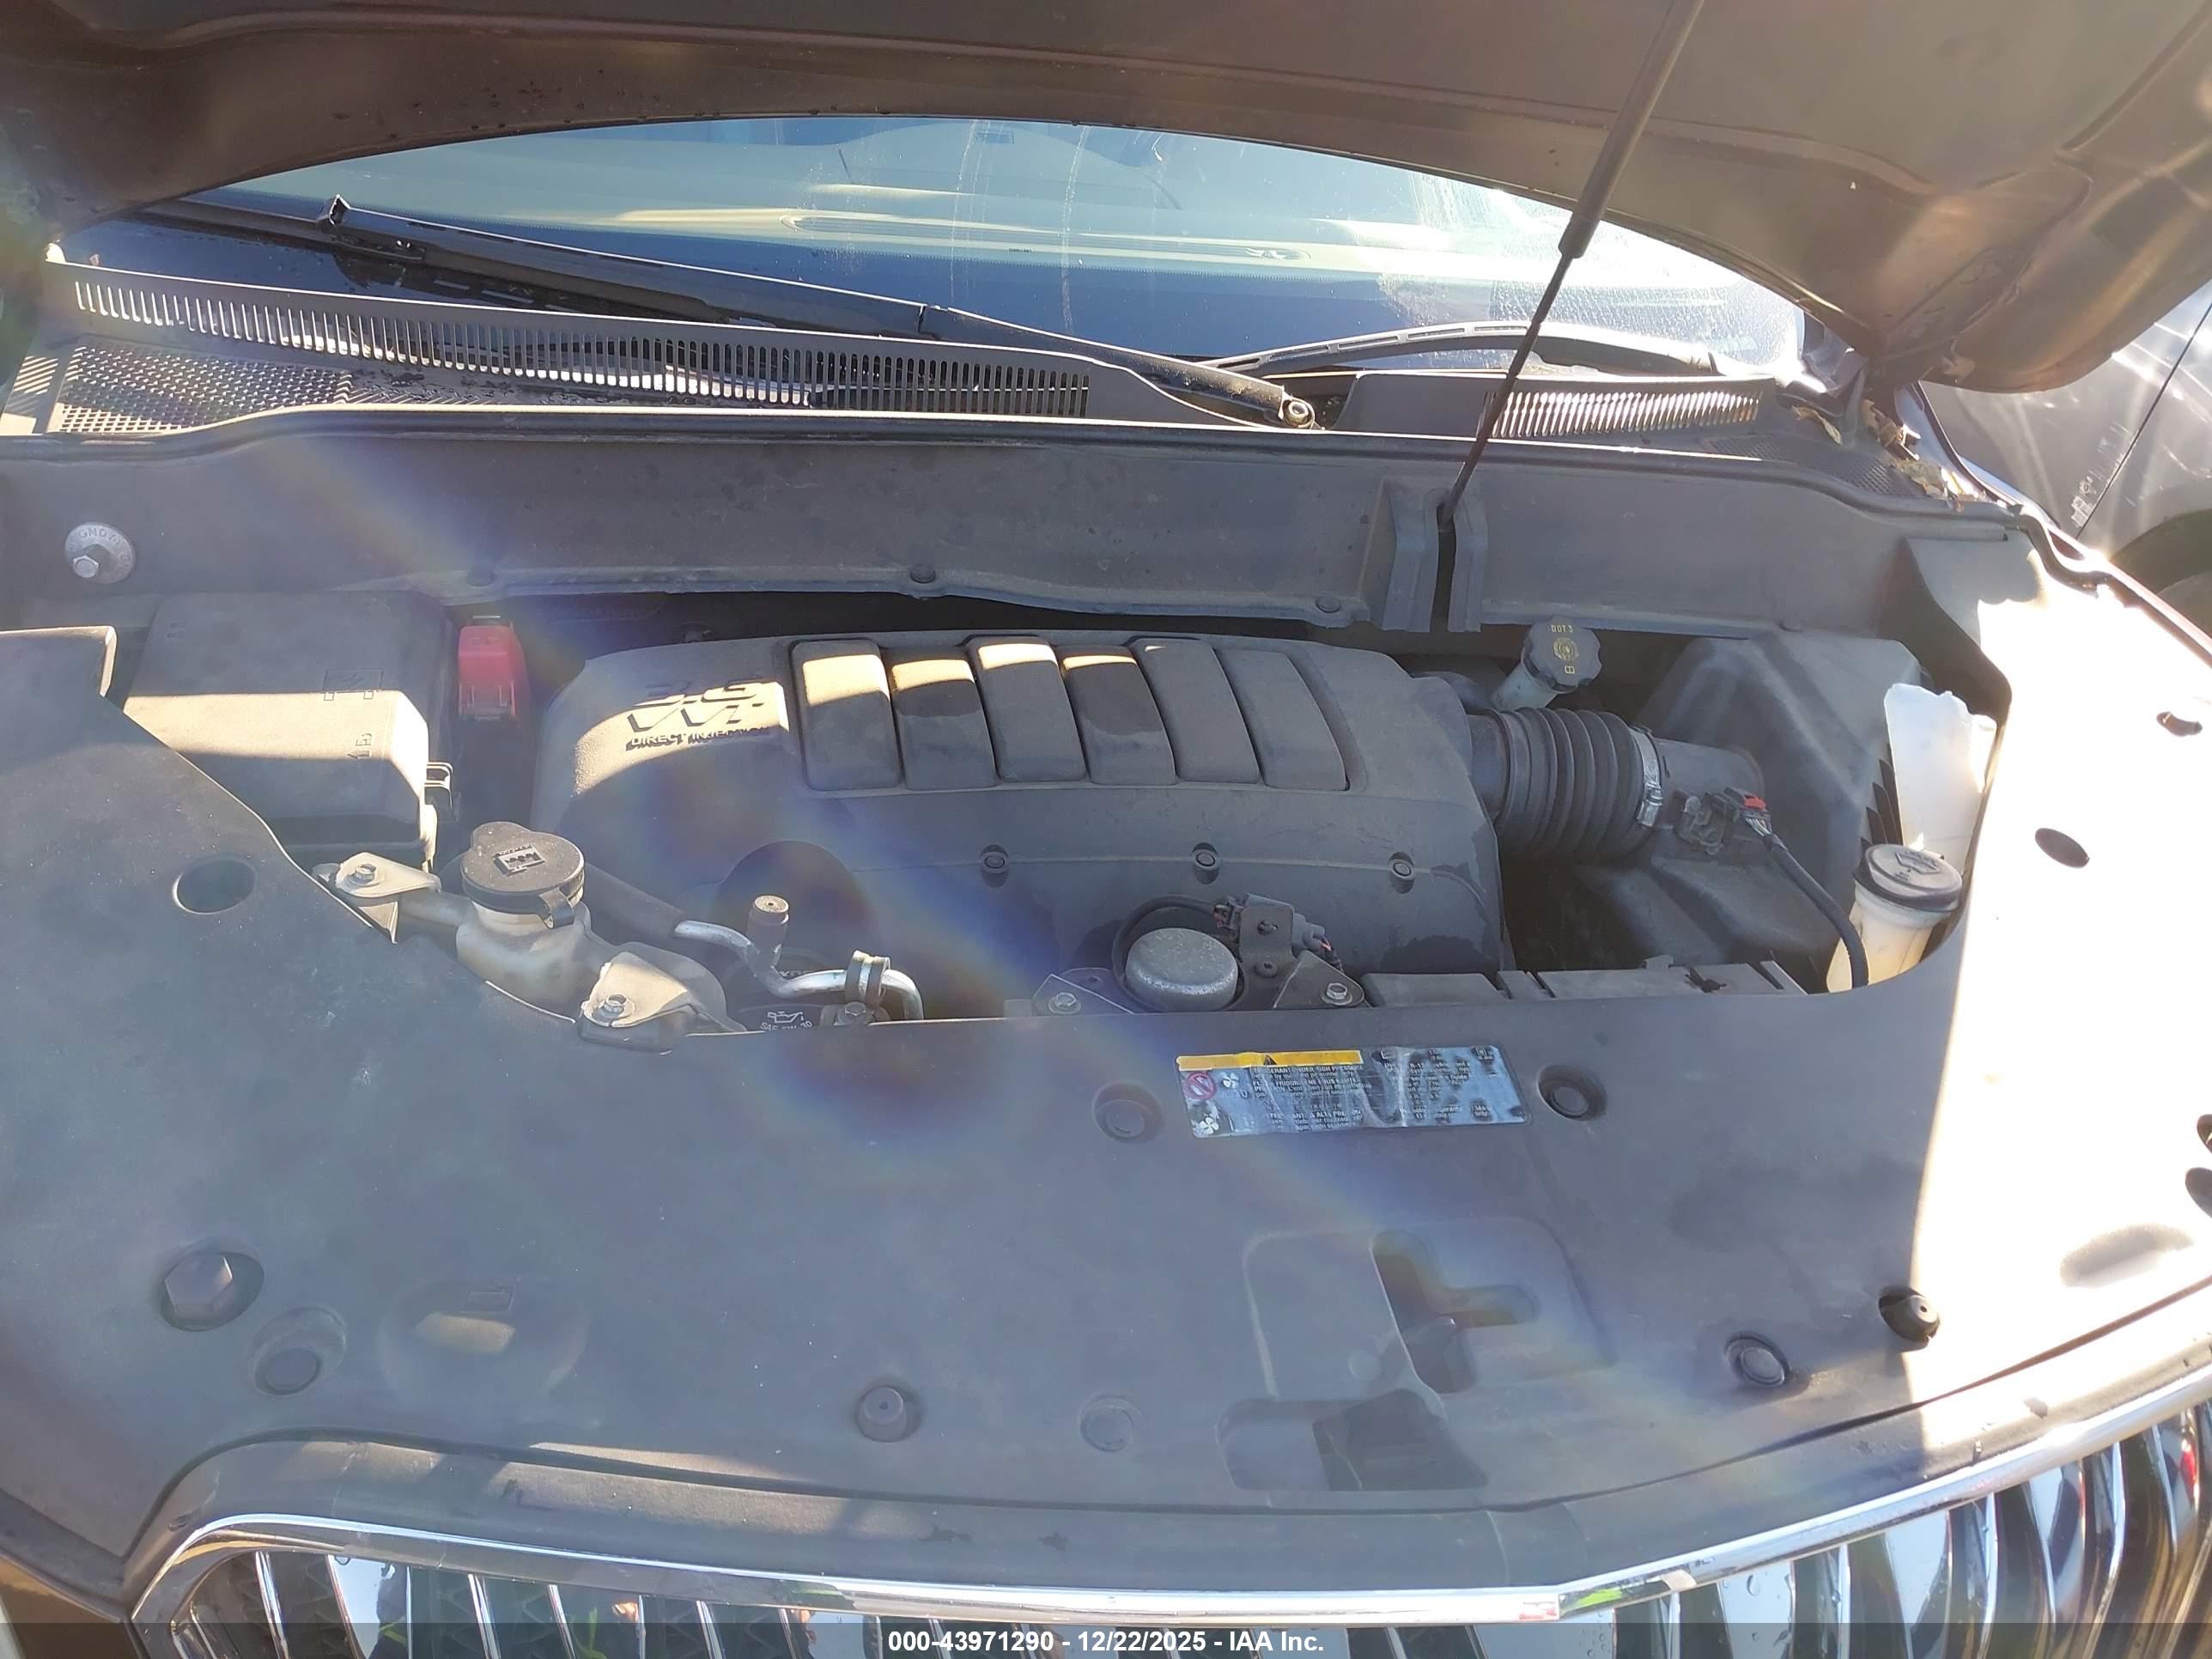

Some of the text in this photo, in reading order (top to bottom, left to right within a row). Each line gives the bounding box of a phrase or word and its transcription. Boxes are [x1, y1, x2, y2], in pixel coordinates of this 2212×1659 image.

[1551, 624, 1574, 633] DOT 3
[625, 733, 684, 751] DIRECT
